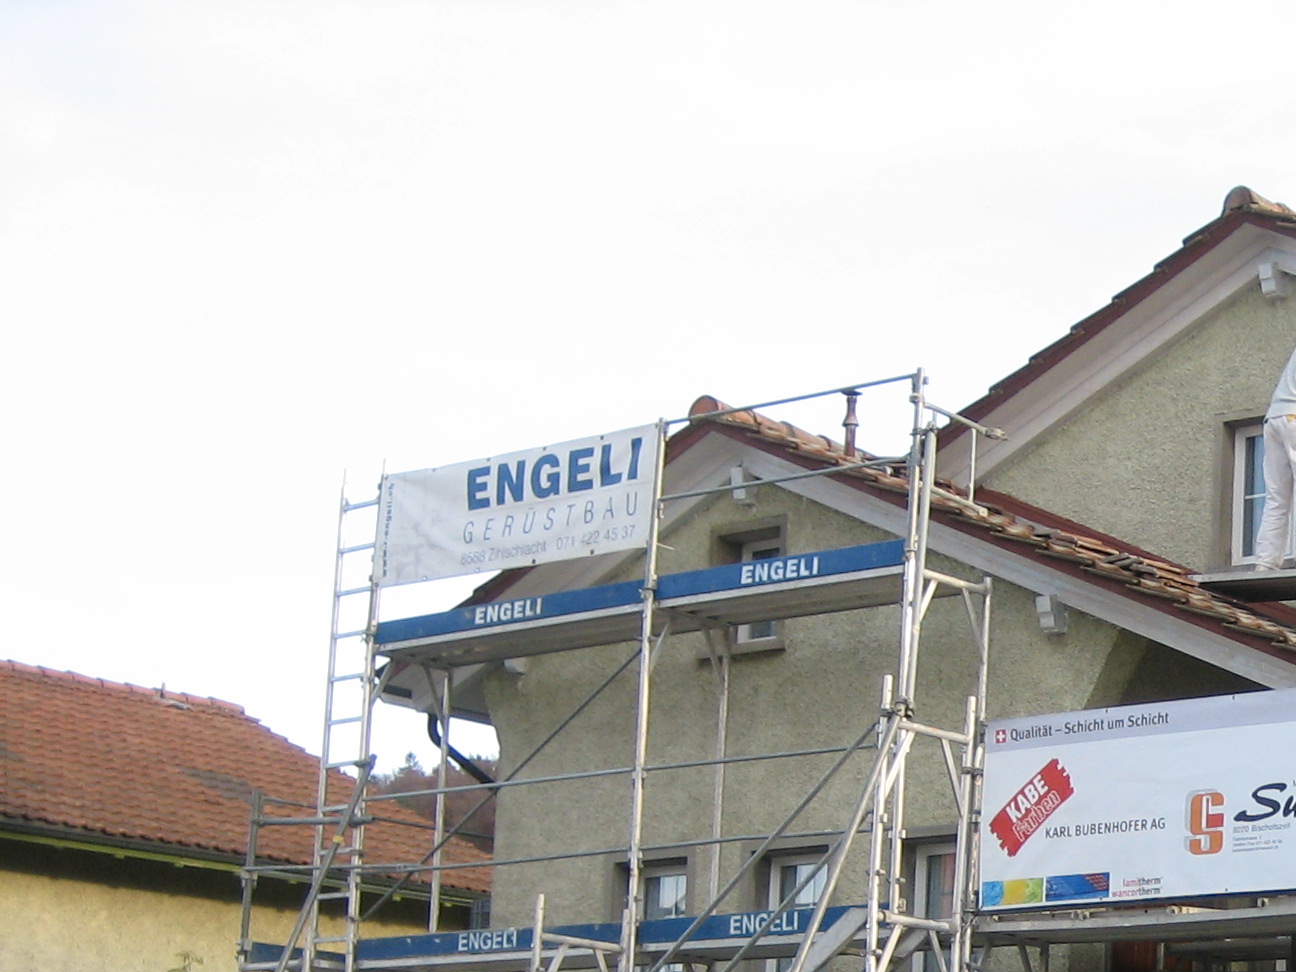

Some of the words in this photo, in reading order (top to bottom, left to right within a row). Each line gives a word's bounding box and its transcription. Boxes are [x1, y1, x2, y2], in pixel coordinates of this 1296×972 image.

[467, 436, 643, 511] ENGELI
[463, 491, 638, 544] GERÜSTBAU
[556, 535, 575, 550] 071
[604, 526, 618, 541] 45
[621, 524, 636, 540] 37
[740, 556, 819, 585] ENGELI
[474, 597, 543, 625] ENGELI
[1010, 724, 1052, 742] Qualität
[1064, 718, 1105, 734] Schicht
[1107, 718, 1125, 730] um
[1127, 711, 1170, 727] Schicht
[1005, 774, 1049, 823] KABE
[1012, 790, 1061, 842] Farben
[1045, 825, 1073, 839] KARL
[1075, 819, 1147, 837] BUBENHOFER
[1150, 817, 1166, 831] AG
[729, 911, 799, 935] ENGELI
[457, 929, 517, 951] ENGELI
